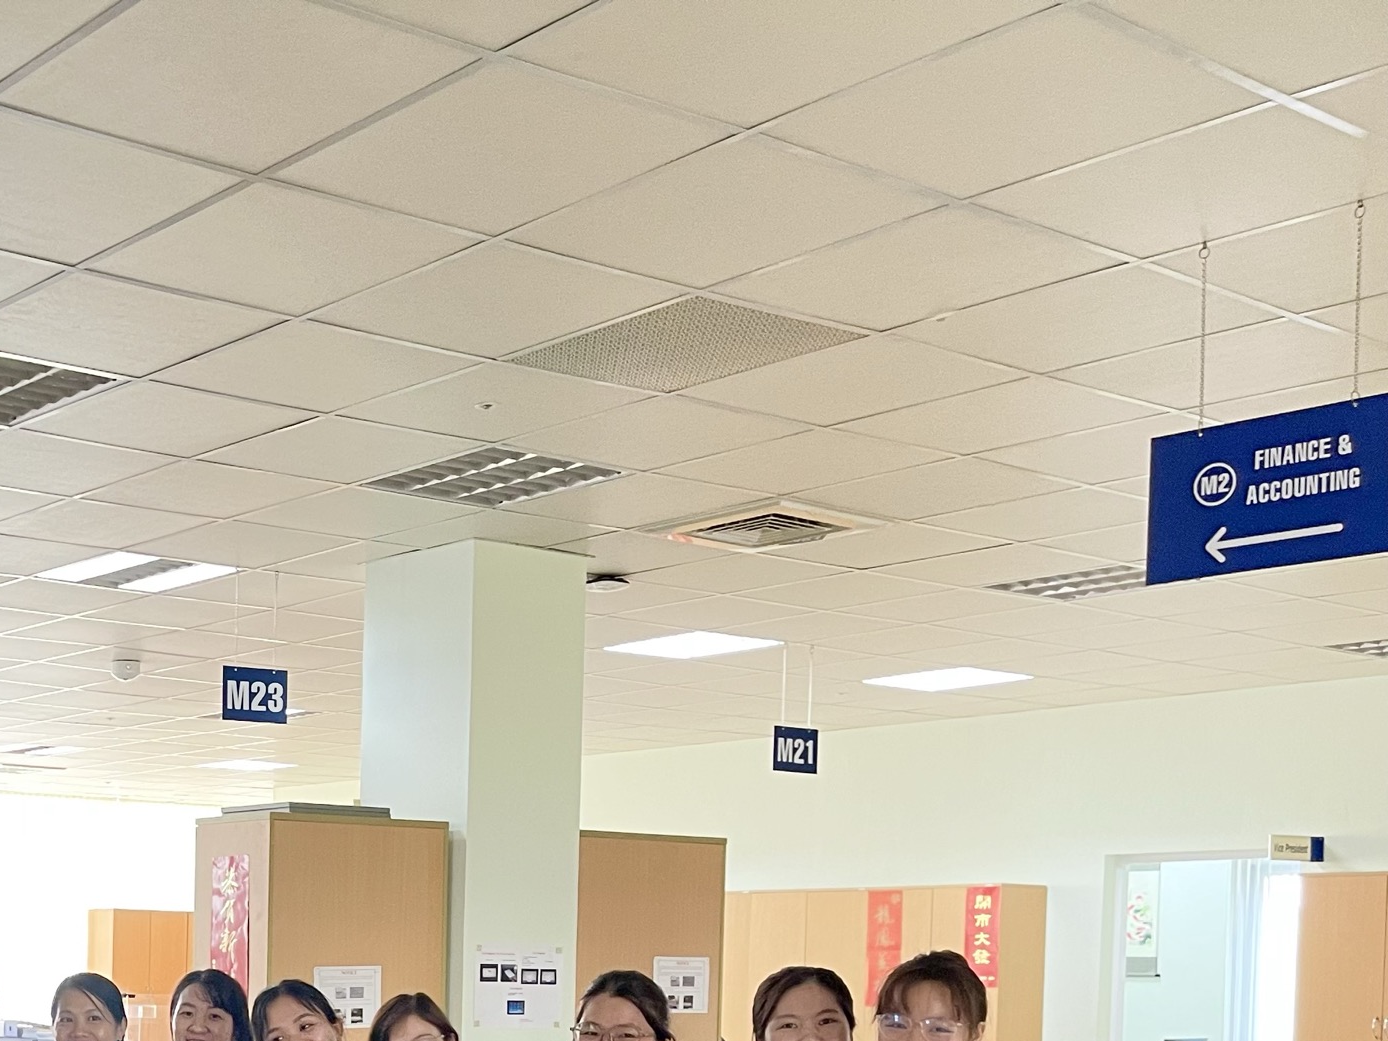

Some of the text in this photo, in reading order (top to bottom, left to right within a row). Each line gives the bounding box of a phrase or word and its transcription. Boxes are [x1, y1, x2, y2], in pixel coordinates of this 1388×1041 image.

[1254, 434, 1353, 470] FINANCE &
[1200, 473, 1230, 497] M2
[1246, 467, 1361, 505] ACCOUNTING
[226, 680, 284, 713] M23
[777, 737, 814, 765] M21
[1285, 844, 1309, 853] President
